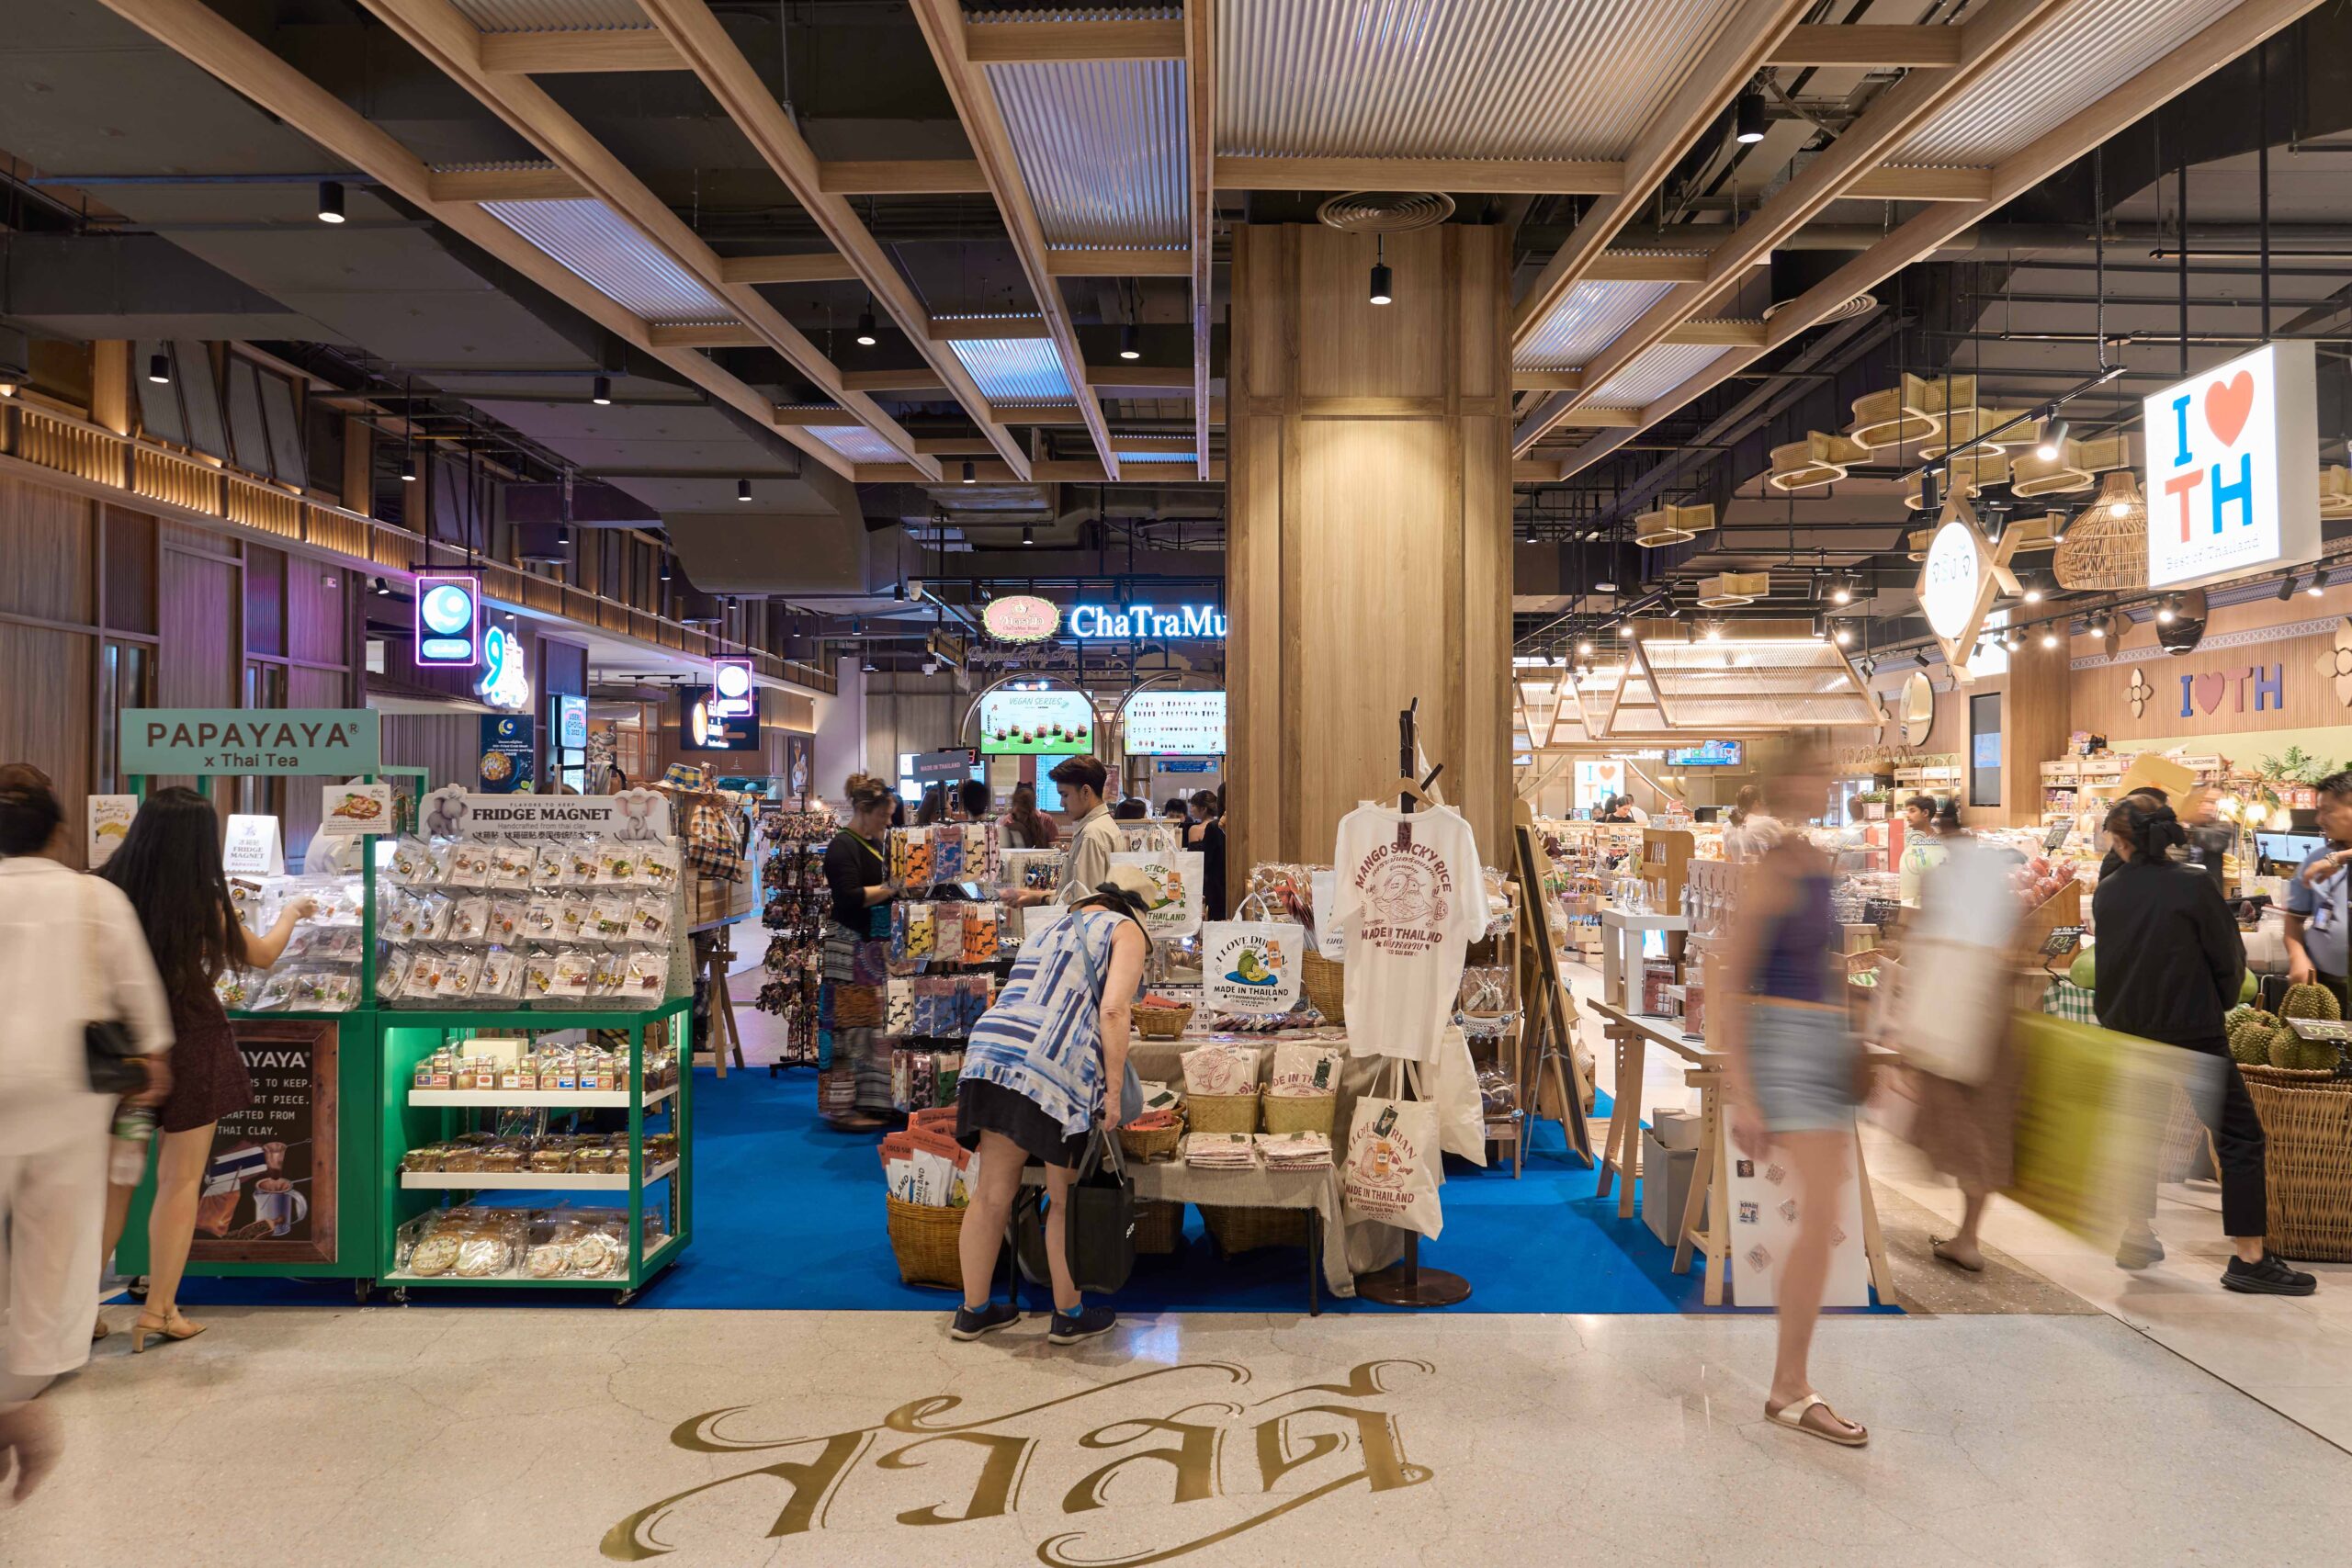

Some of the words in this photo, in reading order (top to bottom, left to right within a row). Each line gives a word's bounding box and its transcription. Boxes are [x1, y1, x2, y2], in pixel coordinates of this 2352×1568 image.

[2172, 394, 2193, 468] I
[2165, 453, 2254, 544] TH
[2226, 663, 2283, 713] TH
[1009, 697, 1033, 705] VEGAN
[1035, 697, 1063, 705] SERIES
[222, 752, 259, 767] Thai
[265, 752, 299, 767] Tea
[472, 808, 536, 820] FRIDGE
[540, 808, 612, 820] MAGNET
[1144, 863, 1171, 874] STICK
[1355, 845, 1388, 889] MANGO
[1391, 841, 1438, 862] SCKY
[1434, 861, 1452, 893] RICE
[1148, 912, 1186, 921] THAILAND
[1361, 927, 1386, 940] MADE
[1220, 936, 1248, 956] LOVE
[1250, 935, 1288, 965] DUN
[1250, 987, 1288, 996] THAILAND
[266, 1078, 277, 1087] TO
[283, 1078, 312, 1088] KEEP.
[1272, 1076, 1285, 1087] DE
[1288, 1073, 1299, 1083] IN
[254, 1095, 267, 1104] RT
[273, 1095, 310, 1105] PIECE.
[221, 1111, 264, 1120] RAFTED
[270, 1111, 295, 1120] FROM
[218, 1126, 242, 1134] THAI
[248, 1126, 277, 1135] CLAY.
[887, 1145, 900, 1153] COCO
[914, 1168, 925, 1205] HAILAND
[1345, 1183, 1362, 1195] MADE
[1363, 1188, 1371, 1198] IN
[1372, 1190, 1415, 1203] THAILAND
